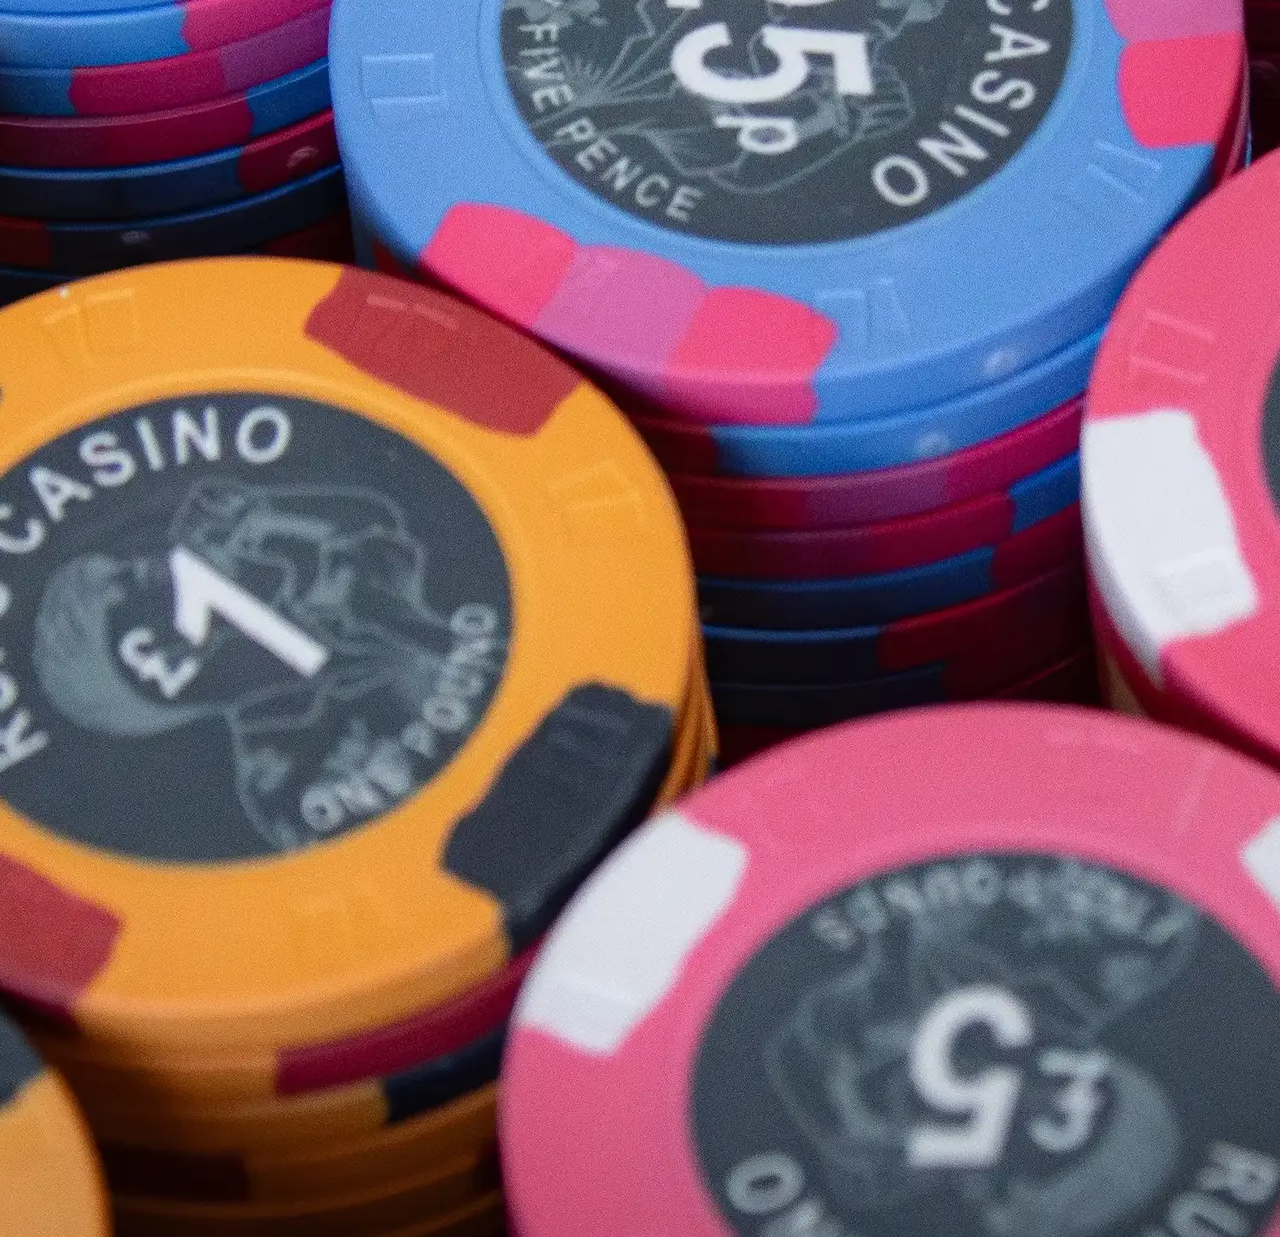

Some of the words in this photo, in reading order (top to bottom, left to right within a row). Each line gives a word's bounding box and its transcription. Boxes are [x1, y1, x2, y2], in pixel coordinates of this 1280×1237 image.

[518, 22, 574, 113] FIVE
[554, 115, 705, 224] PENCE
[119, 544, 331, 699] £1
[400, 601, 498, 759] POUND
[906, 981, 1116, 1169] £5
